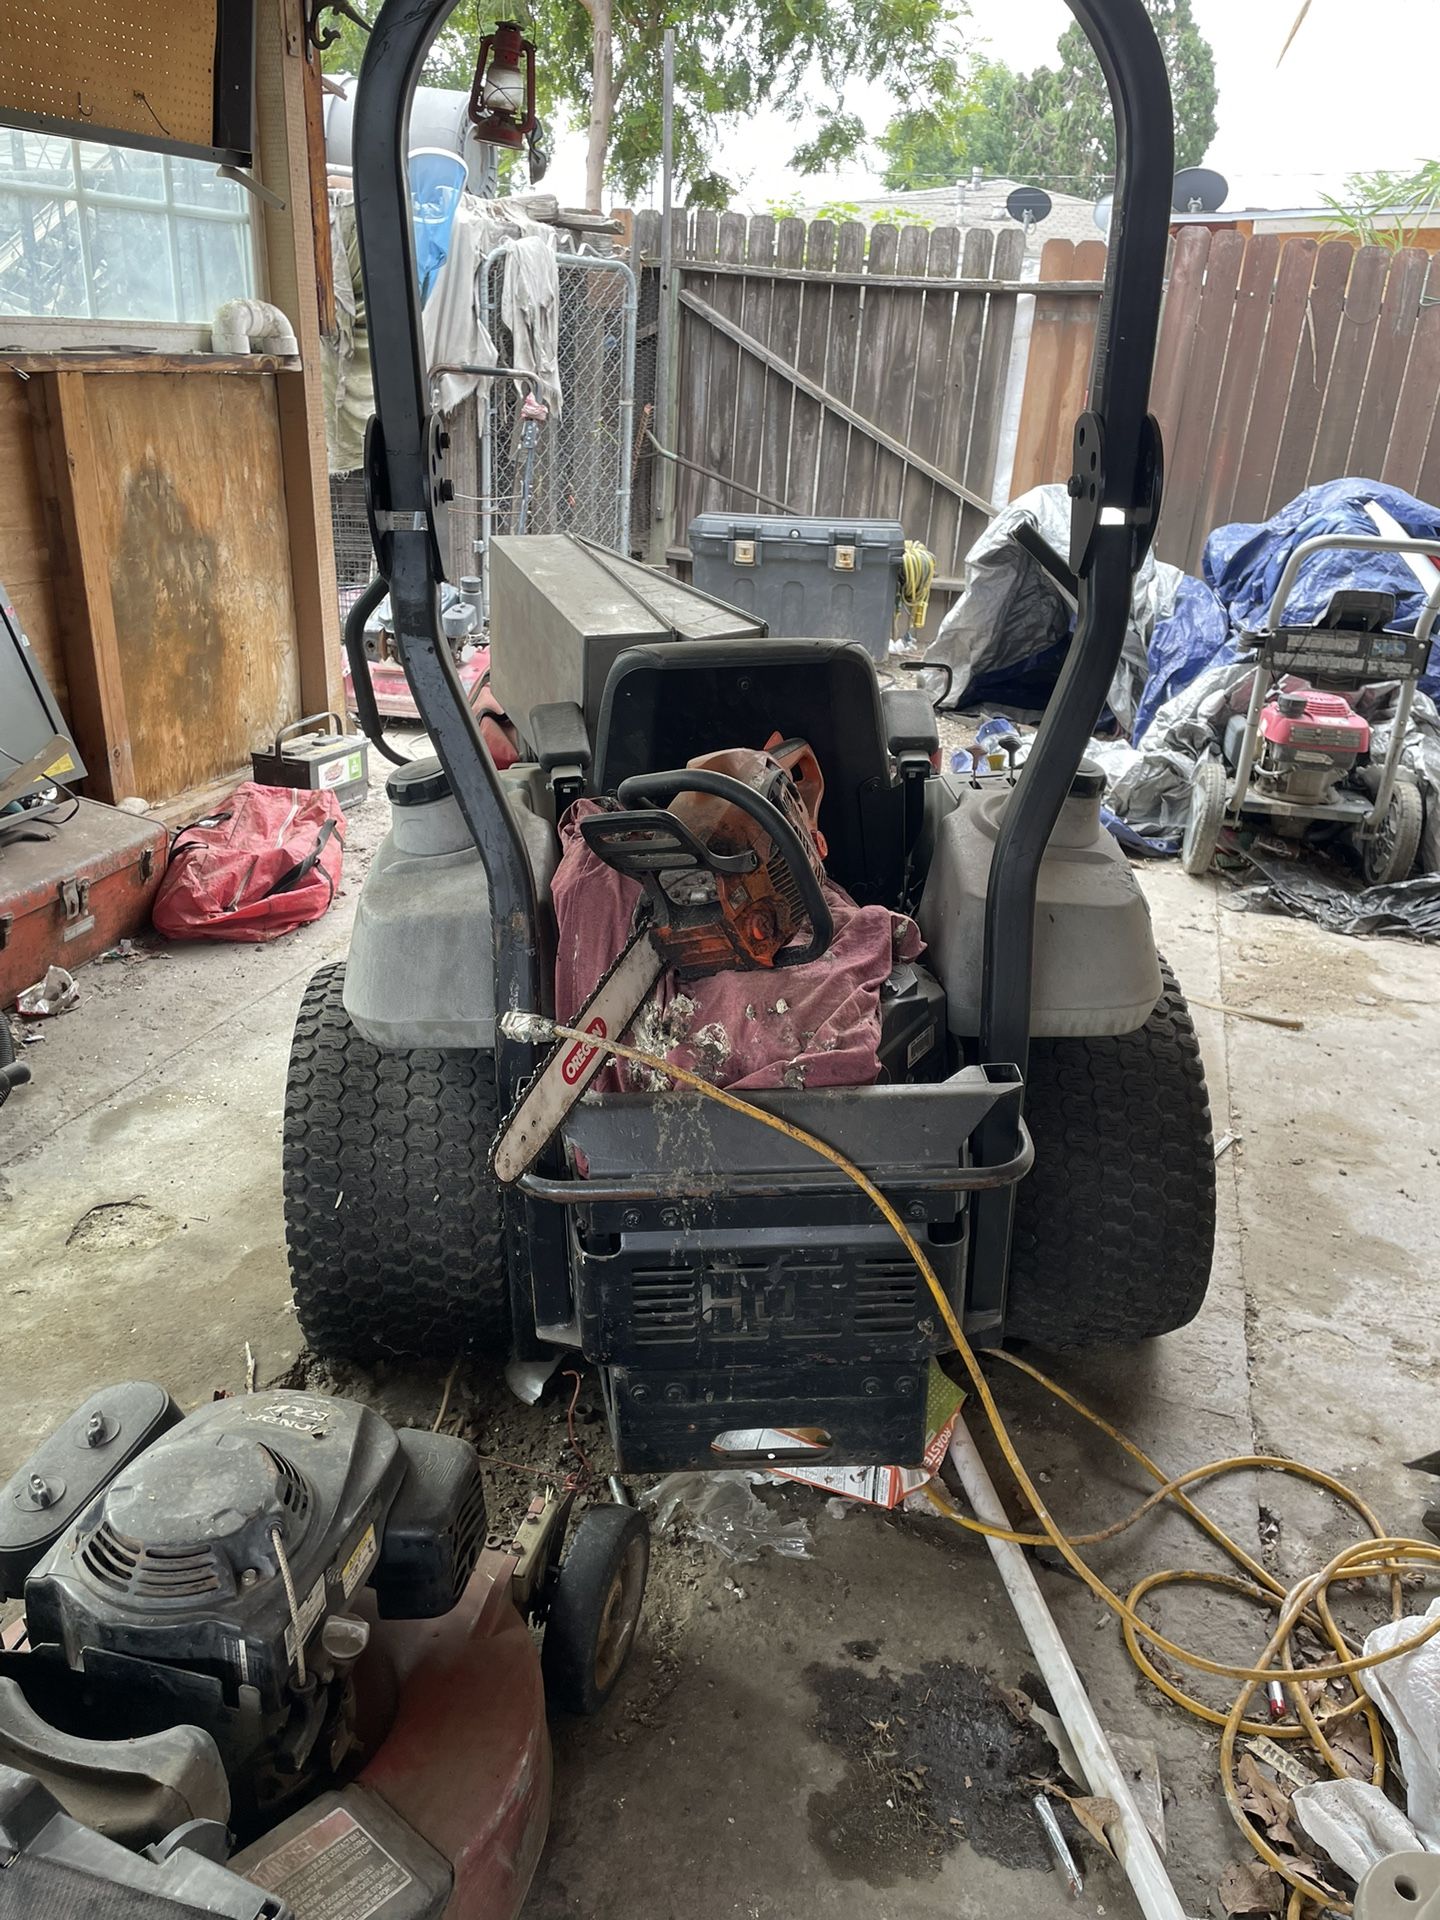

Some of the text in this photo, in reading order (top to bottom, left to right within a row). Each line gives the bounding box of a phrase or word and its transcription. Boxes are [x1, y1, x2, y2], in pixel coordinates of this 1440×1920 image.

[566, 1023, 603, 1079] OREGN
[922, 1427, 952, 1468] ROASTE
[251, 1838, 317, 1888] DANGER
